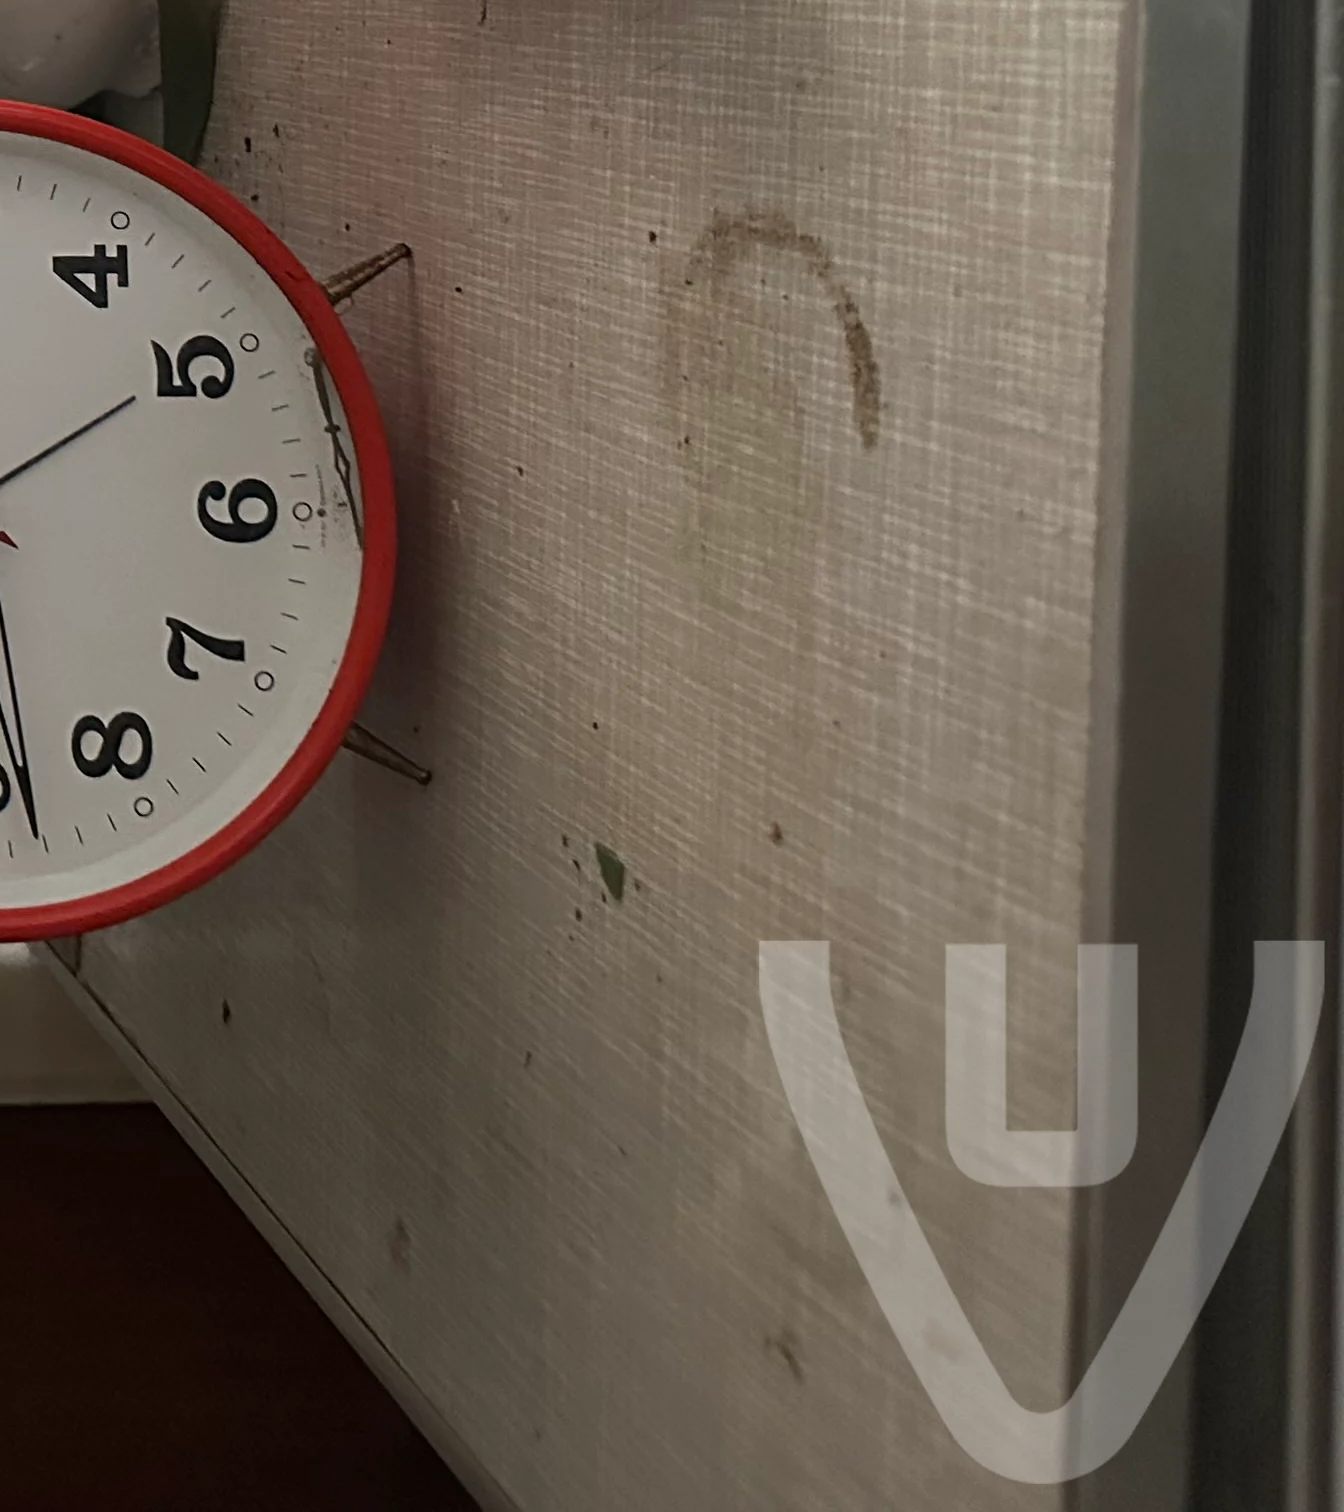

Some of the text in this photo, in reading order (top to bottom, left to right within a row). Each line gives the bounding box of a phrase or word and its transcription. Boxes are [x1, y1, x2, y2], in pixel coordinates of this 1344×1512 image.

[52, 244, 129, 309] 4
[150, 335, 235, 400] 5
[197, 478, 278, 544] 6
[165, 616, 246, 681] 7
[71, 711, 153, 781] 8
